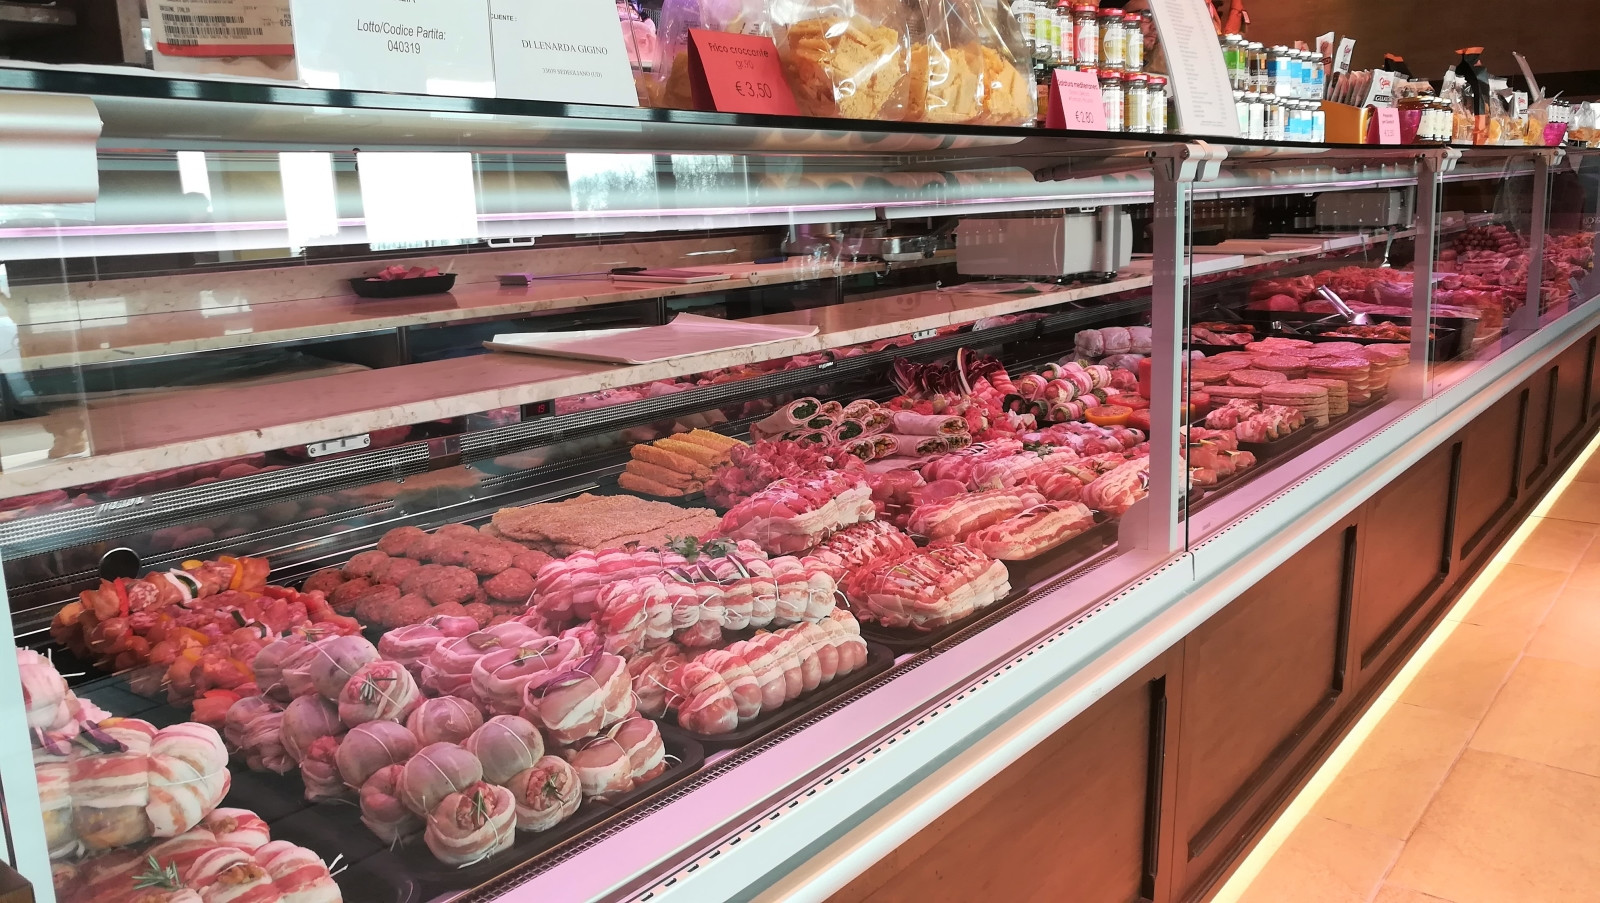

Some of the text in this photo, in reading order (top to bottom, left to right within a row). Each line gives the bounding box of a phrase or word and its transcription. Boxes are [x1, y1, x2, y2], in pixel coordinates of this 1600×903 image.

[357, 19, 446, 41] Lotto/Codice Partita:
[387, 39, 421, 54] 040319
[521, 39, 608, 56] DI LENARDA GIGINO
[708, 42, 769, 58] Frico croccante
